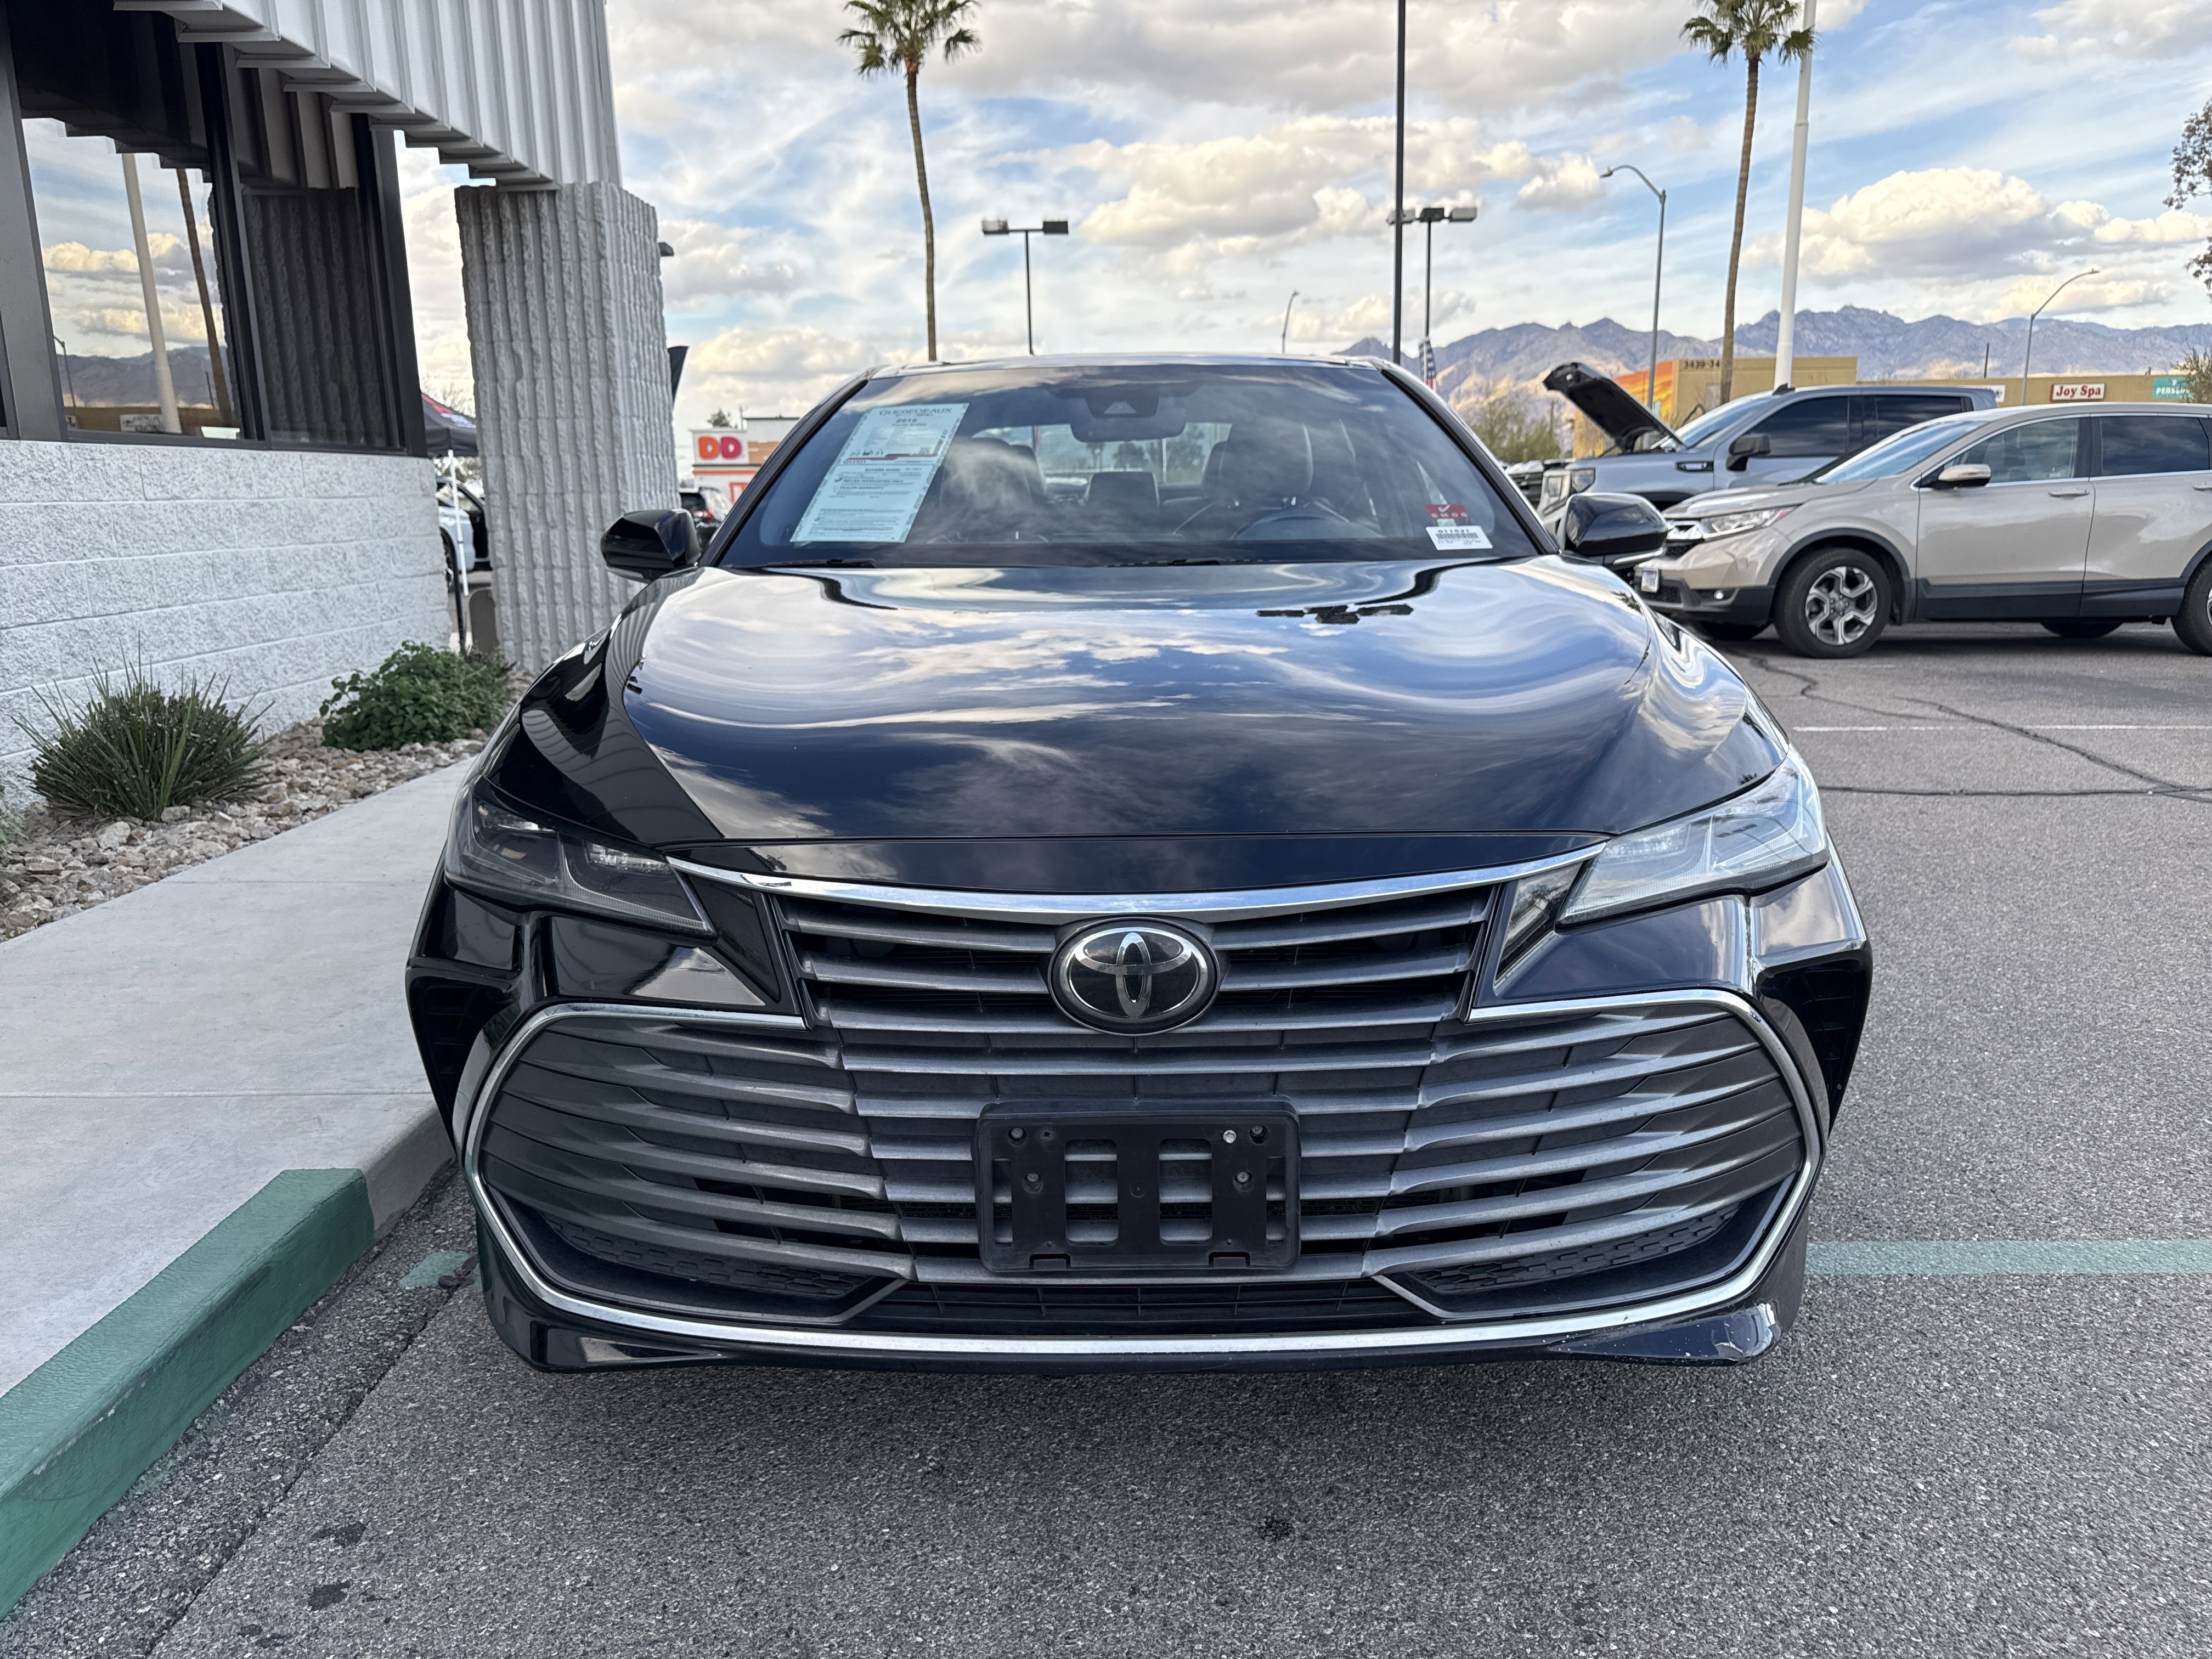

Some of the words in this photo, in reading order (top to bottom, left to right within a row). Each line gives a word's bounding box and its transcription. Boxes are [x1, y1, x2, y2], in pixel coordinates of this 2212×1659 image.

[1684, 359, 1720, 369] 3439-34
[2056, 386, 2077, 399] Joy
[2080, 385, 2101, 398] Spa
[698, 436, 742, 460] DD
